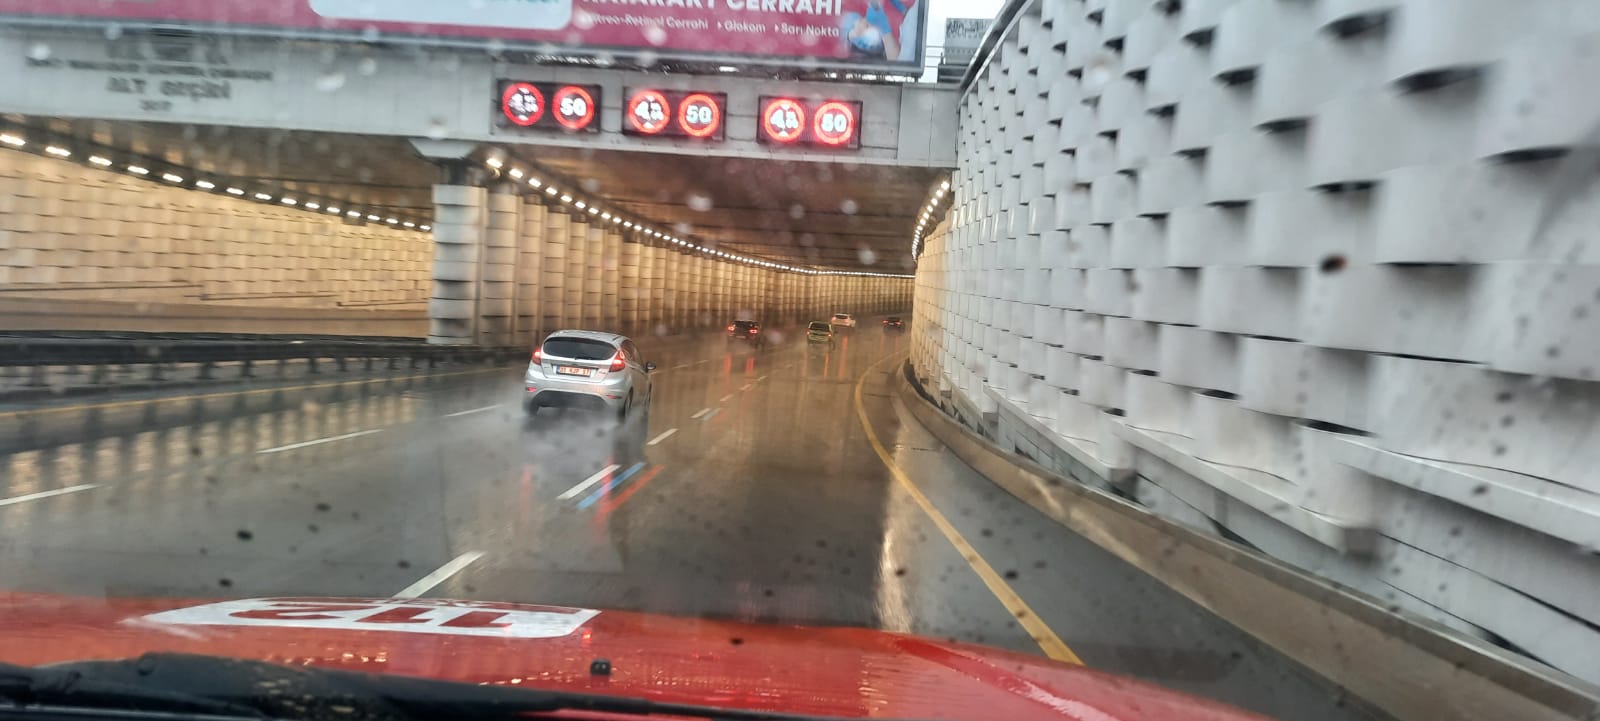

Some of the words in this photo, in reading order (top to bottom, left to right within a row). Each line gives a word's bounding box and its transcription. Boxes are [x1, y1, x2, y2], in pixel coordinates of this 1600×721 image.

[666, 16, 709, 30] Cerrahi
[725, 20, 766, 33] Glokom
[806, 25, 840, 37] Nokta
[559, 97, 587, 117] 50
[686, 104, 712, 124] 50
[821, 113, 847, 132] 50
